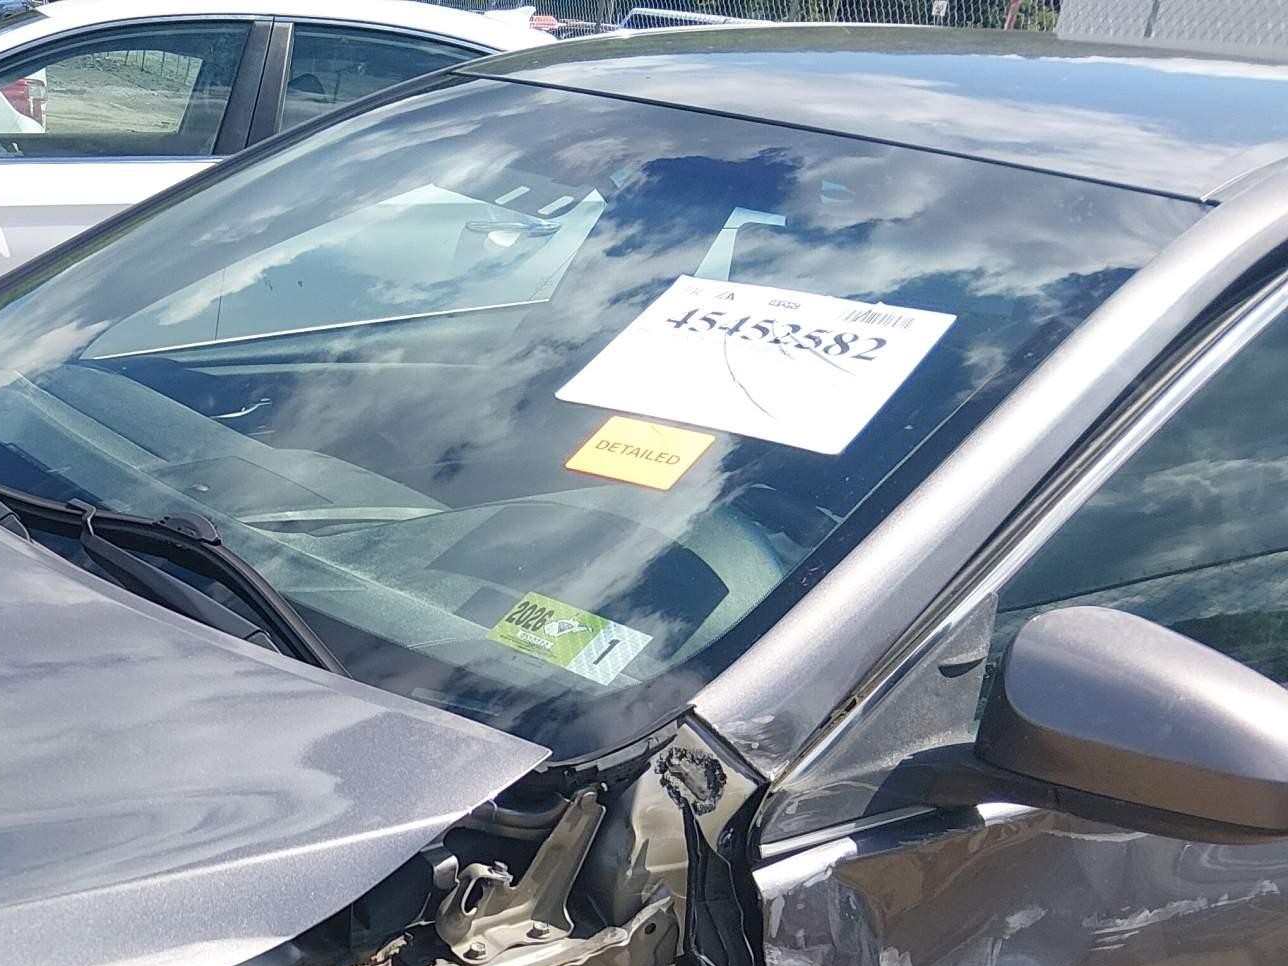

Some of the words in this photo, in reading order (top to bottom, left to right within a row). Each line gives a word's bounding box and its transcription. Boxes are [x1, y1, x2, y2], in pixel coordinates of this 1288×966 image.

[666, 308, 889, 362] 45452582
[594, 438, 681, 467] DETAILED
[505, 601, 554, 632] 2026
[593, 639, 621, 665] 1
